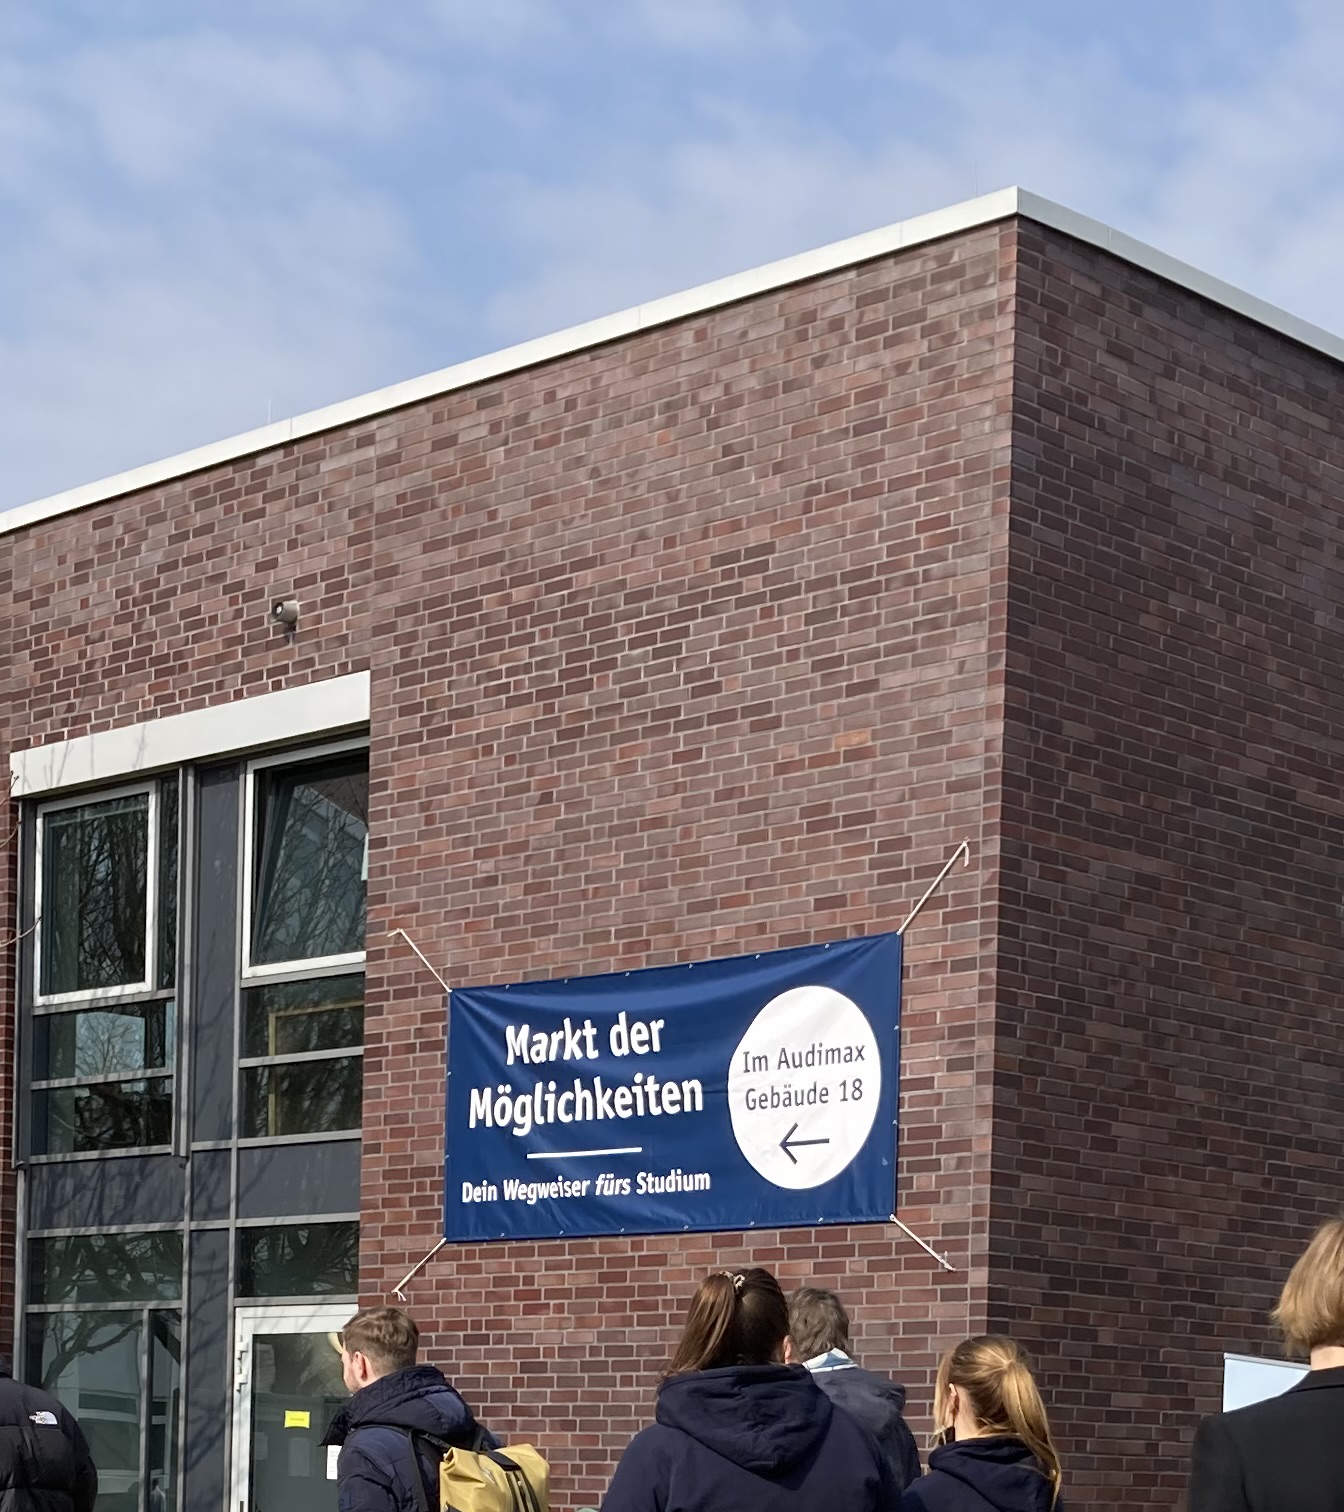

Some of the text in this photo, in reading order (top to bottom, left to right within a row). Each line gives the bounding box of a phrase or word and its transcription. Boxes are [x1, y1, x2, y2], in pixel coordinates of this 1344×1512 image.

[506, 1011, 665, 1066] Markt der
[743, 1042, 865, 1073] Im Audimax
[468, 1072, 704, 1137] Möglichkeiten
[745, 1078, 863, 1111] Gebäude 18
[462, 1168, 712, 1205] Dein Wegweiser fürs Studium
